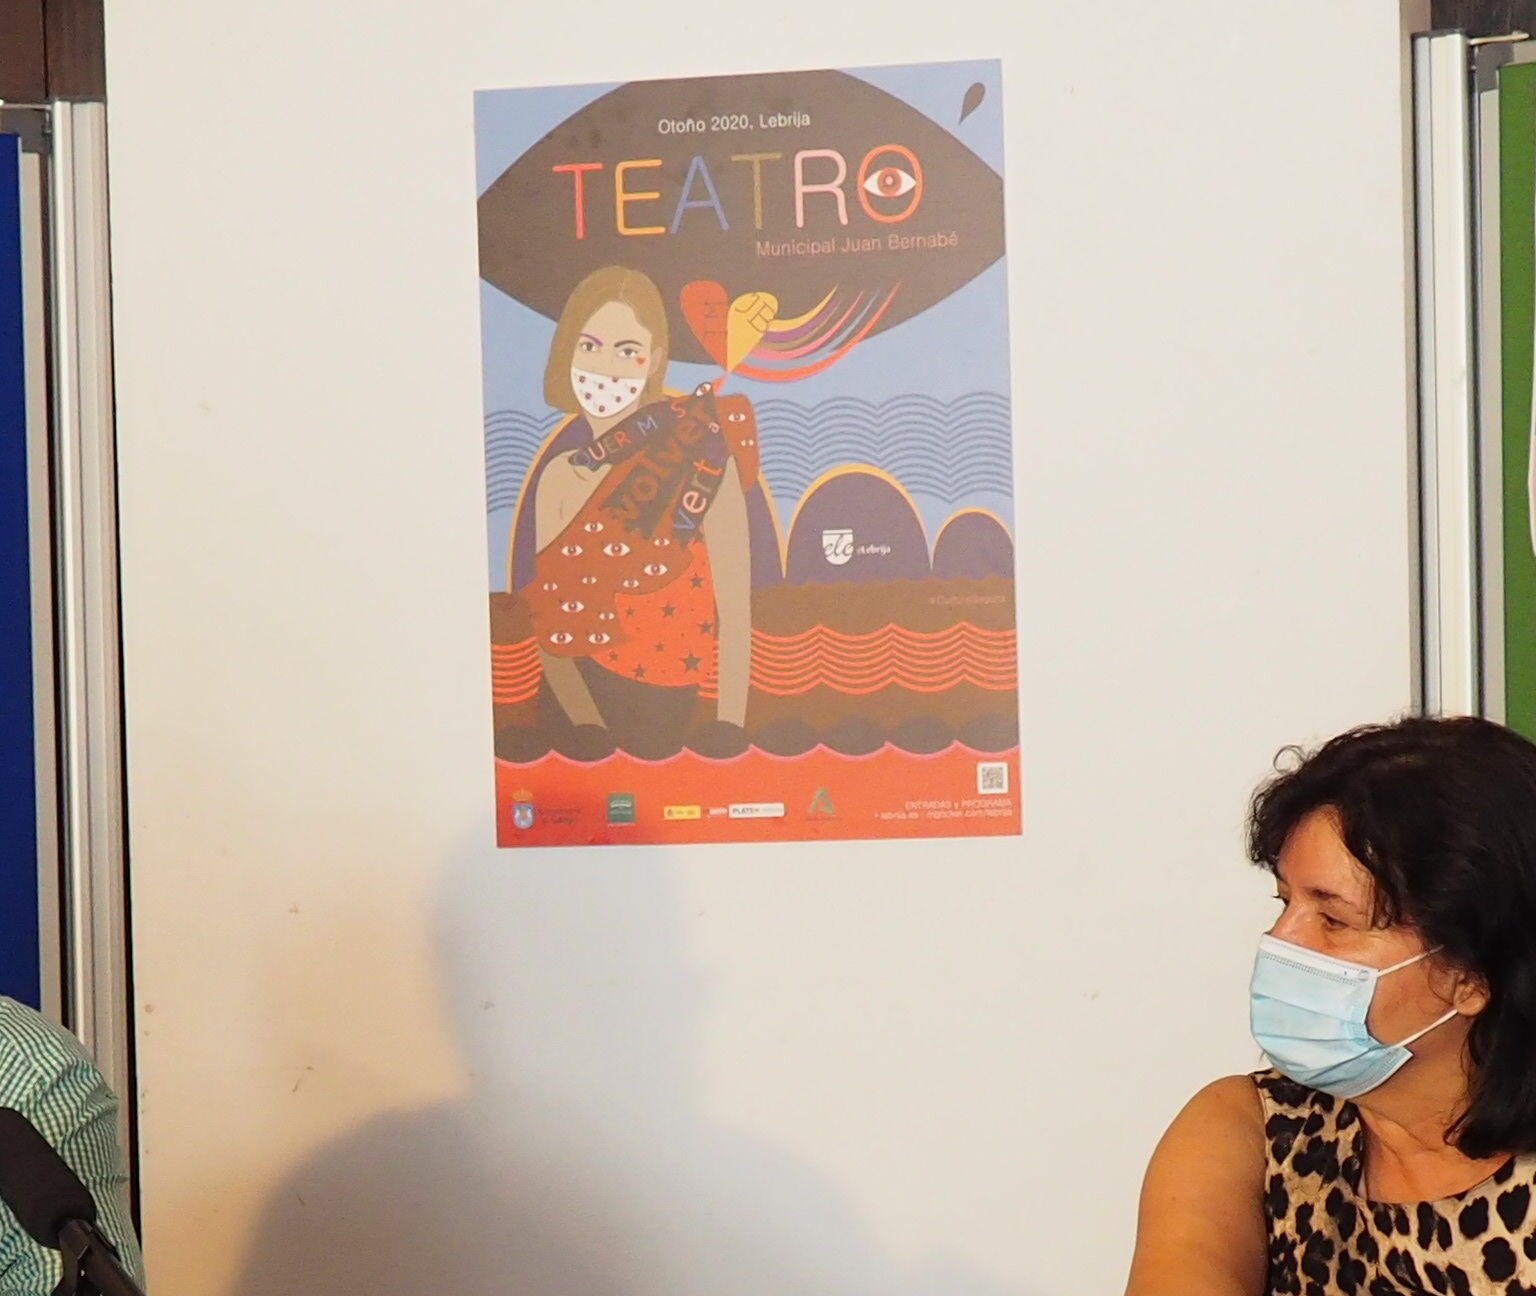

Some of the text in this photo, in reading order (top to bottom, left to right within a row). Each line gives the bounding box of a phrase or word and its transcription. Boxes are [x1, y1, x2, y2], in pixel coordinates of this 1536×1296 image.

[658, 111, 811, 136] Otoño 2020. Lebrija
[552, 144, 923, 240] TEATRO
[756, 231, 959, 259] Municipal Juan Bernabé
